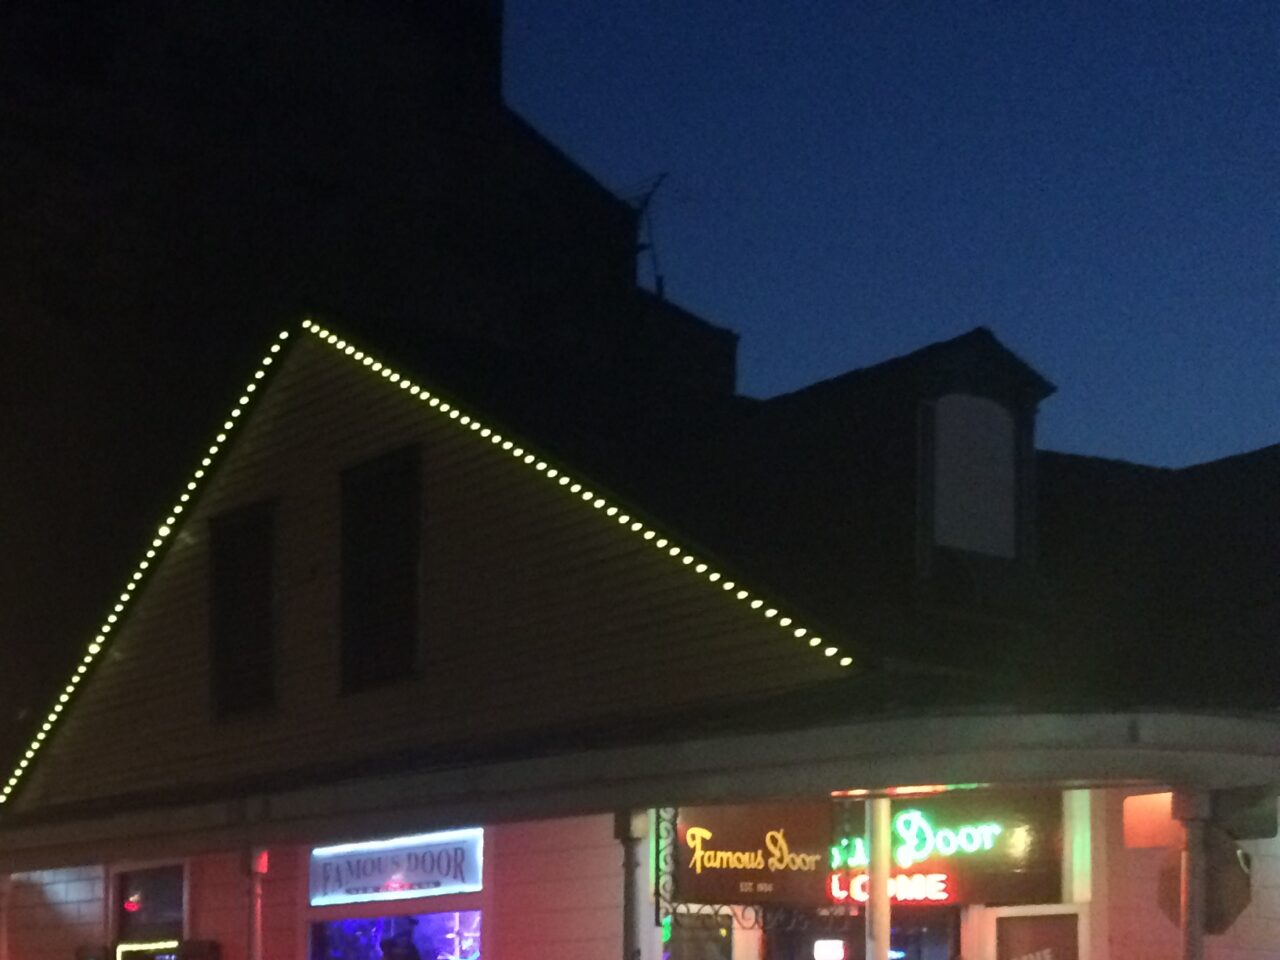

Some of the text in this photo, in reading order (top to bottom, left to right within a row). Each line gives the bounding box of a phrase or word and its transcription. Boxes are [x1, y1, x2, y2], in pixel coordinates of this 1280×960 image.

[685, 826, 765, 875] Famous
[765, 828, 821, 872] Door
[893, 810, 1003, 870] Door
[321, 853, 402, 897] FAMOUS
[407, 846, 468, 884] DOOR
